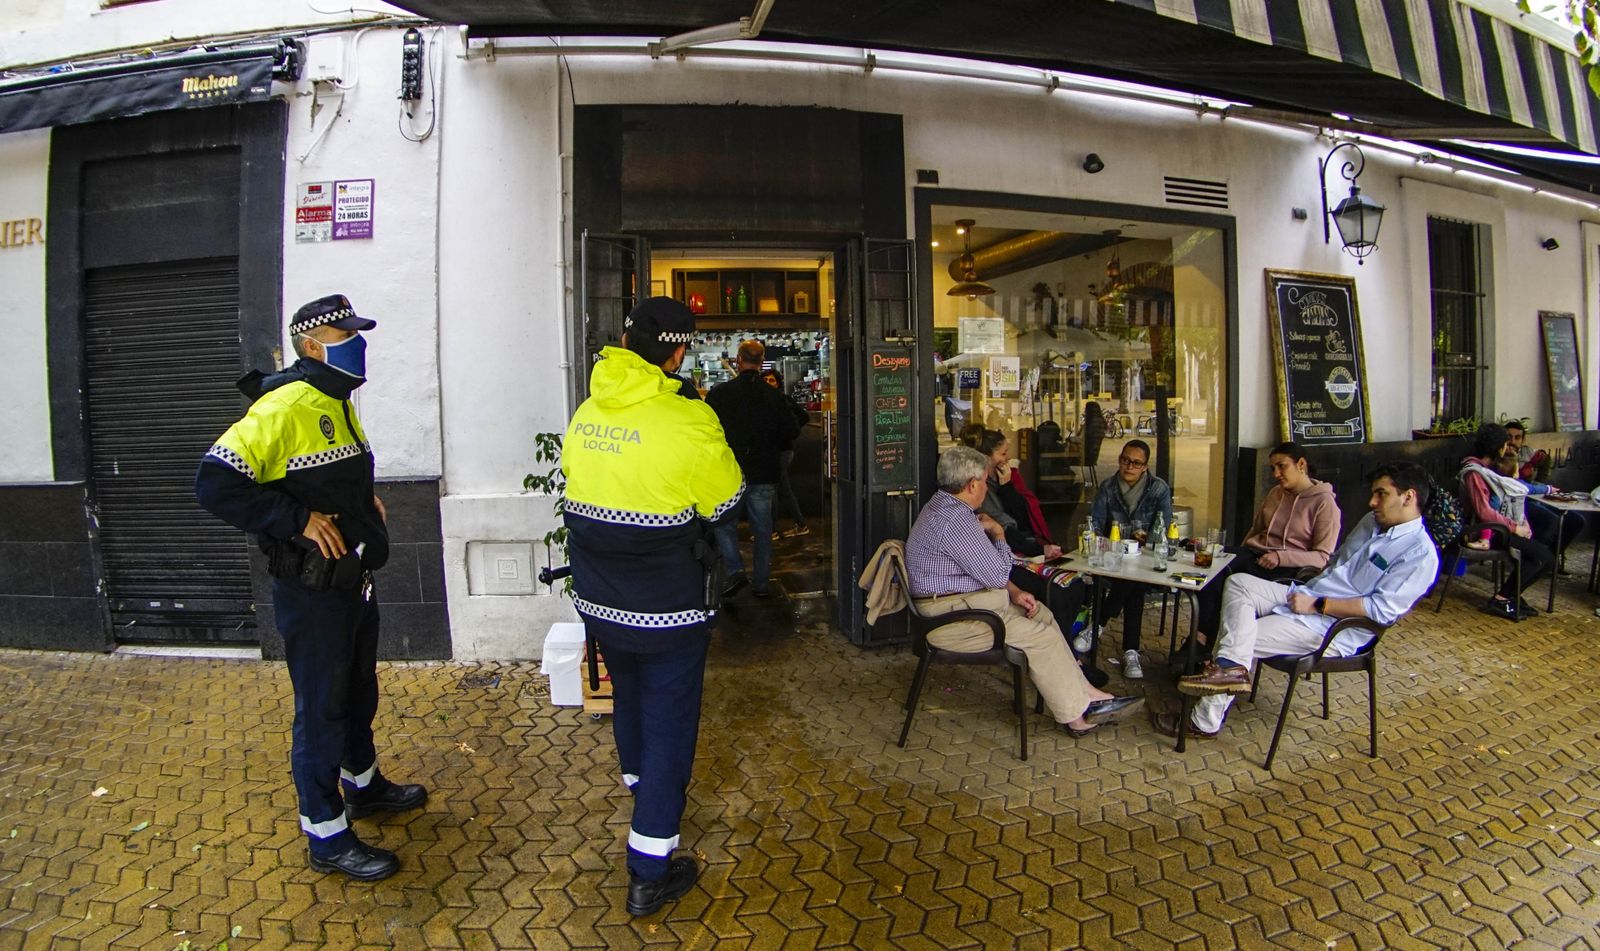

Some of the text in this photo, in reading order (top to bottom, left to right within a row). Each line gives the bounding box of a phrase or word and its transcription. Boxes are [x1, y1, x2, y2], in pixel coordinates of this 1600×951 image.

[182, 74, 238, 92] Mahou
[298, 209, 331, 217] Alarma
[338, 212, 346, 220] 24
[347, 211, 368, 219] HORAS
[960, 370, 978, 379] FREE
[574, 423, 642, 445] POLICIA
[583, 440, 623, 454] LOCAL
